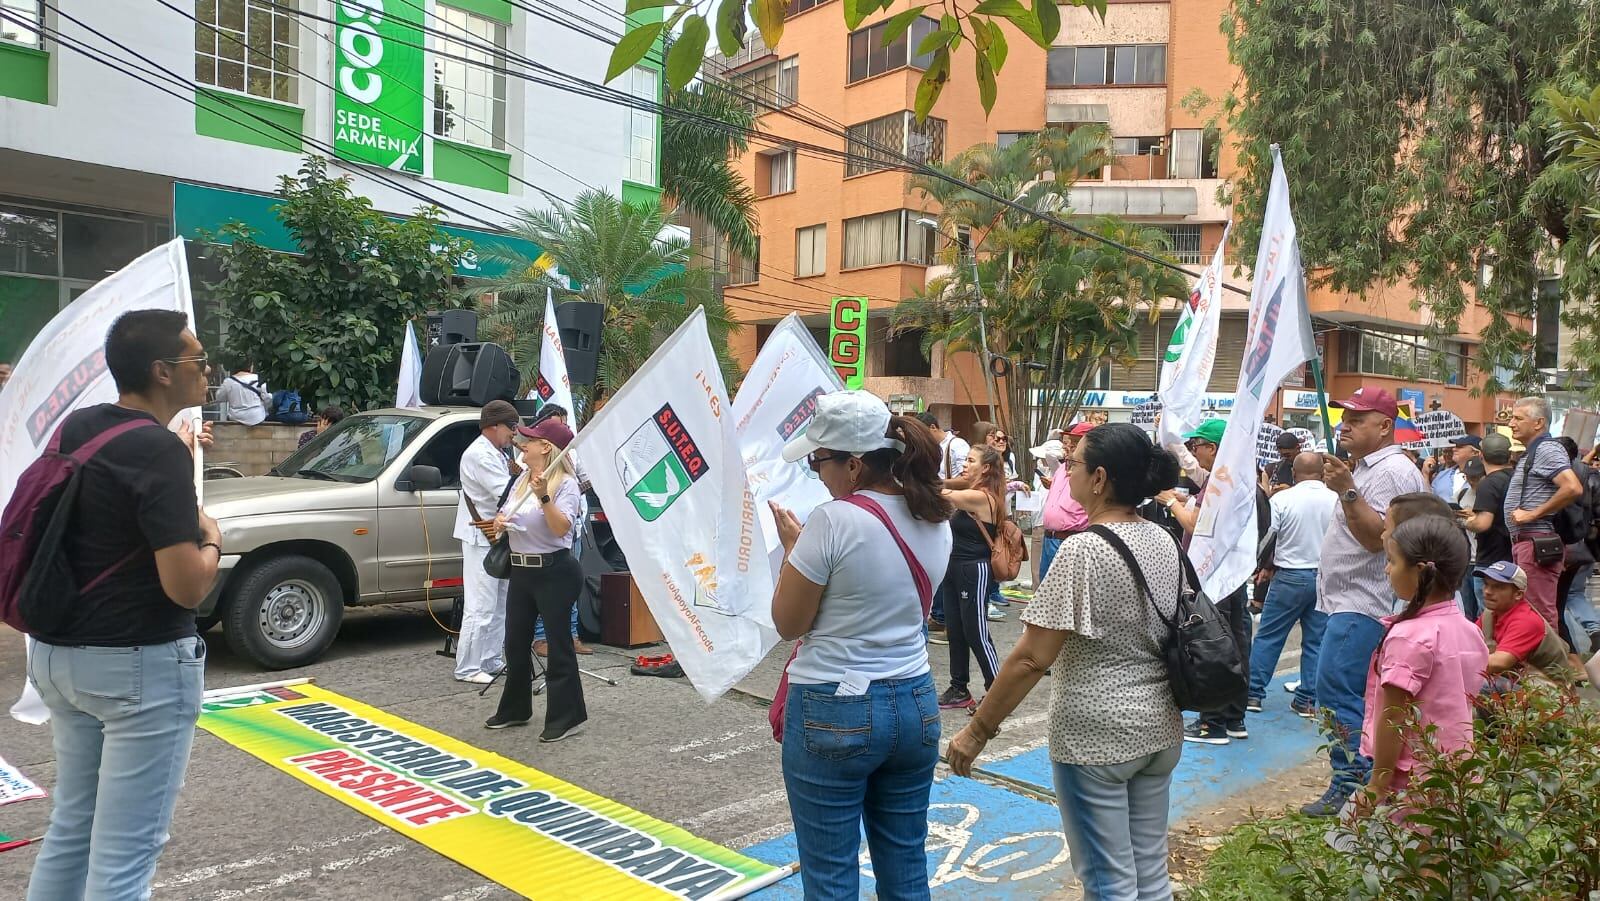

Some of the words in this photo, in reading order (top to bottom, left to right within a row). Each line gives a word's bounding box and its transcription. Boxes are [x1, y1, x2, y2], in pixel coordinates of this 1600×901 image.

[336, 127, 419, 157] ARMENIA
[337, 109, 381, 132] SEDE
[658, 408, 704, 476] S.U.T.E.Q.
[662, 571, 715, 653] #YoApoyoAFecode
[276, 702, 473, 776] MAGISTERIO
[437, 769, 524, 799] DE
[488, 791, 740, 900] QUIMBAYA
[289, 750, 472, 826] PRESENTE
